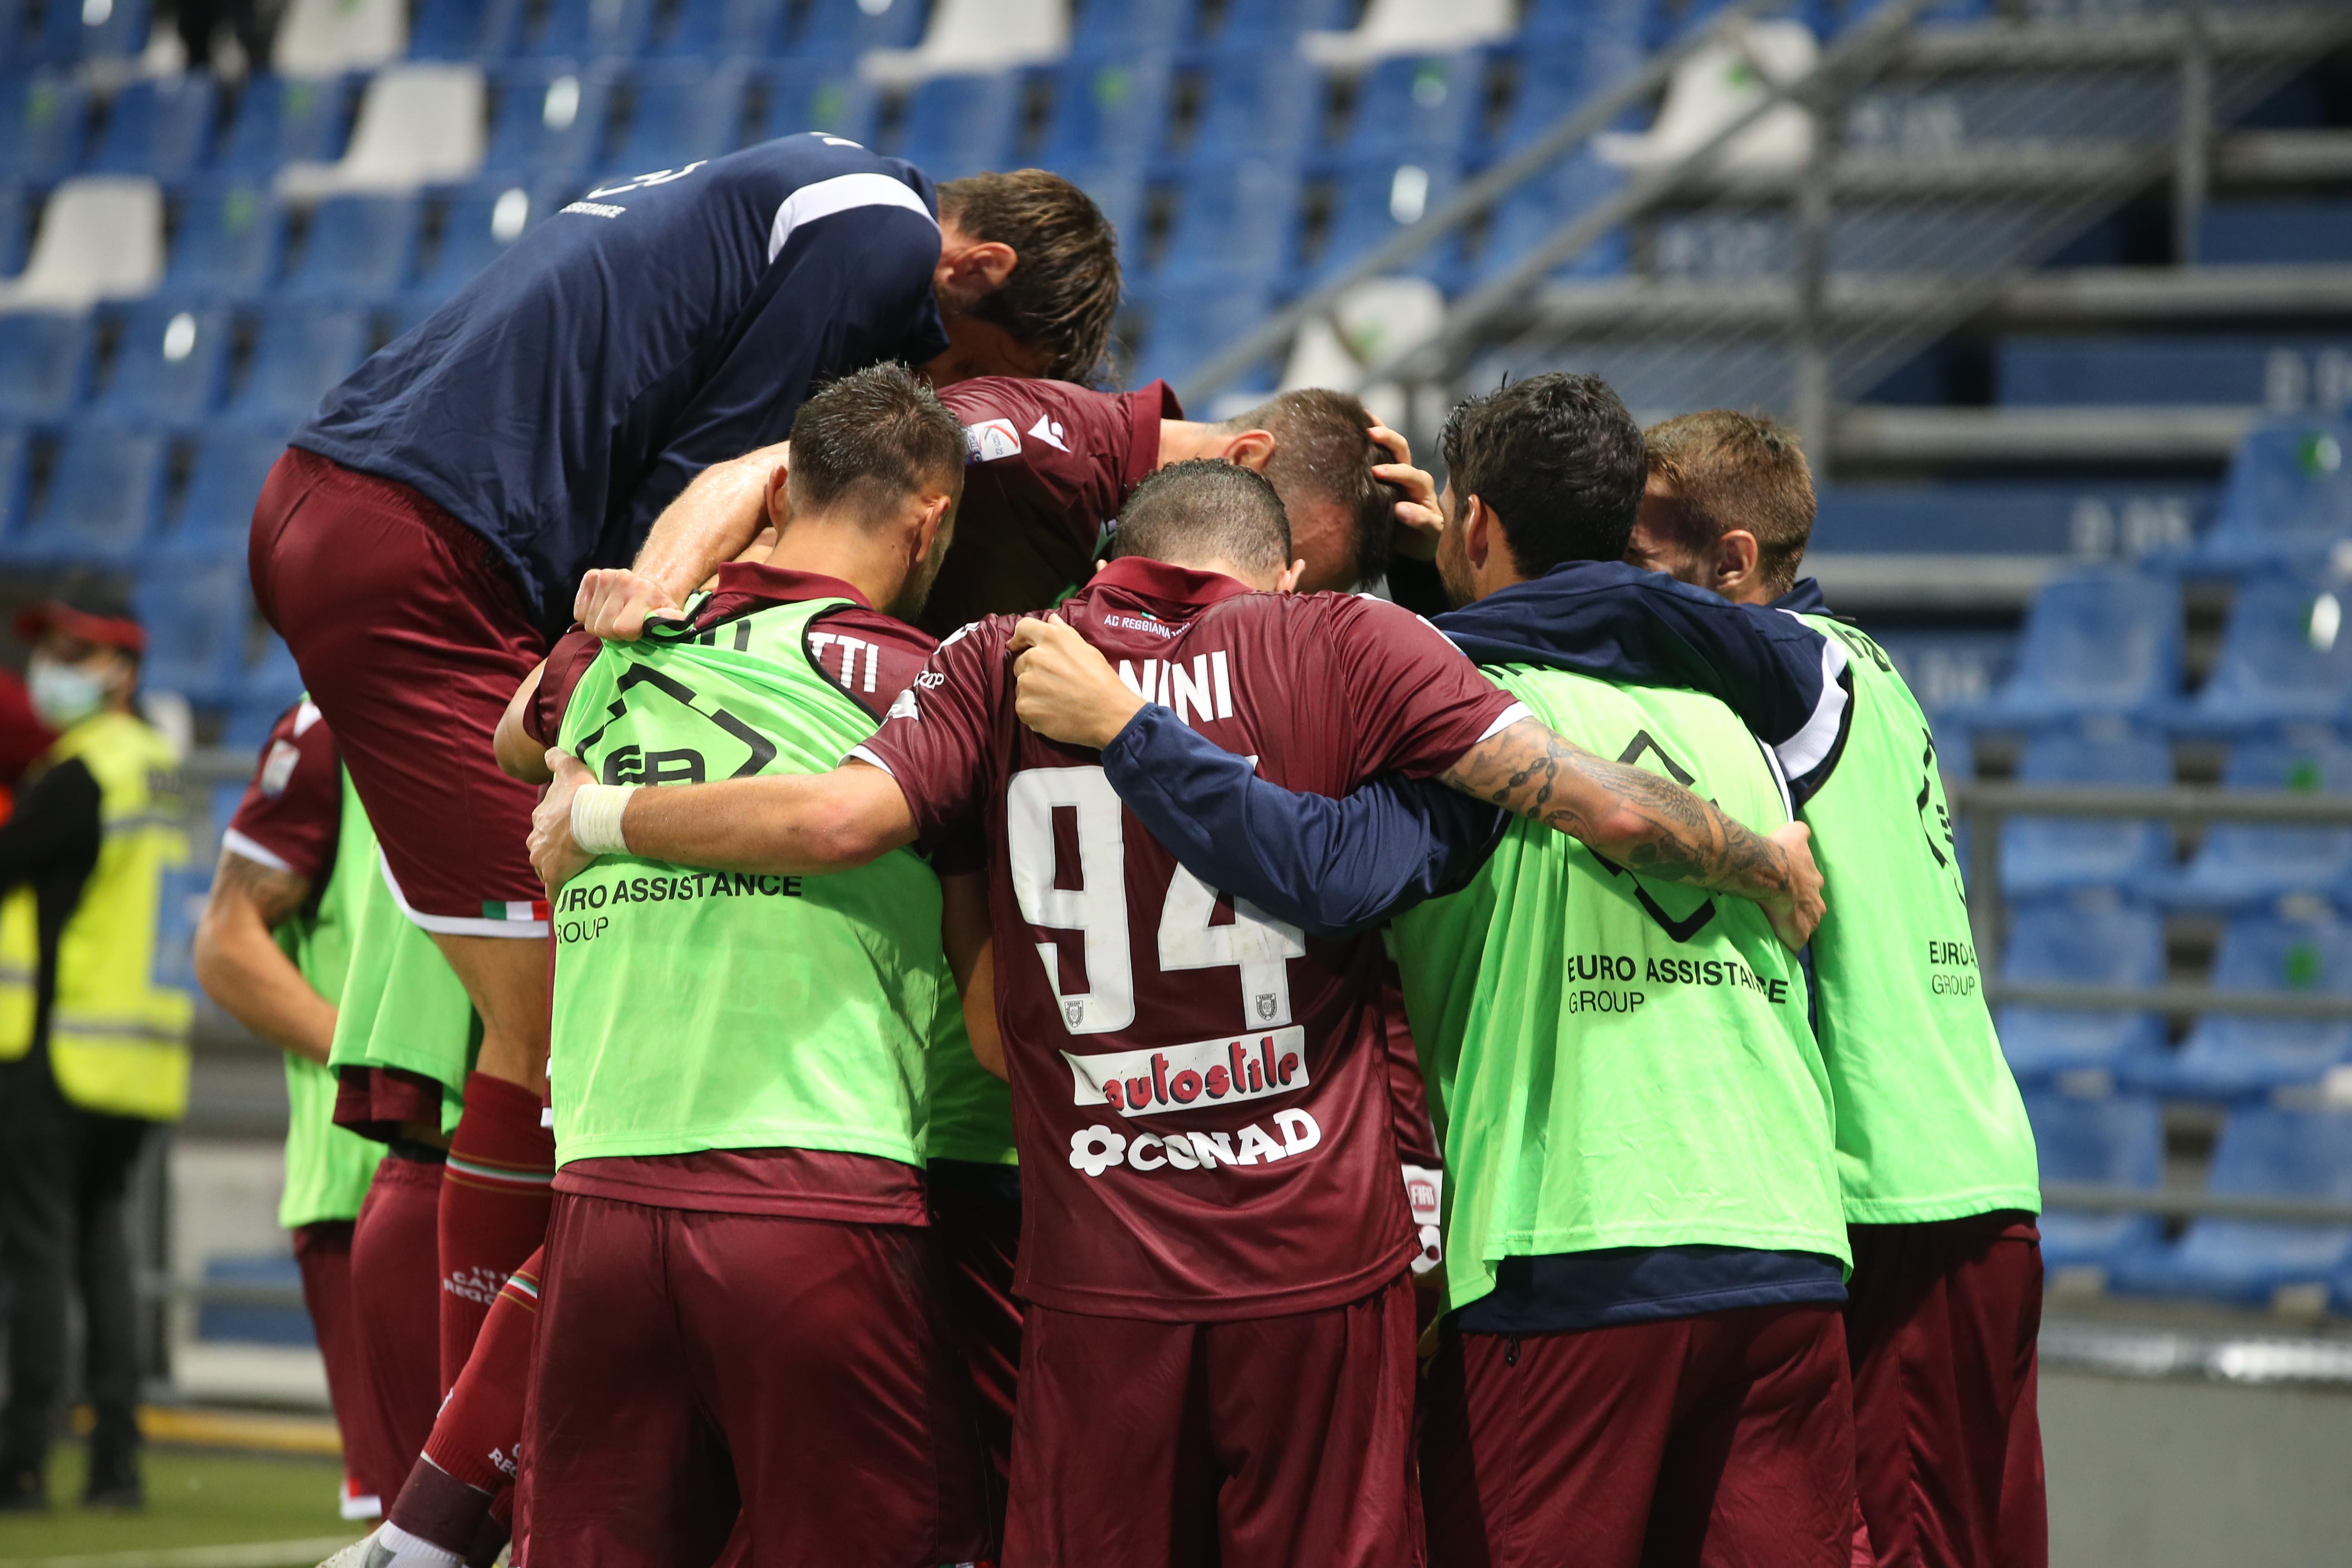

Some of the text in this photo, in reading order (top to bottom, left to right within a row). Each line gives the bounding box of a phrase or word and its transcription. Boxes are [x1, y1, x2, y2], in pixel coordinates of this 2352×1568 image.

[1104, 614, 1120, 627] AC
[1122, 617, 1171, 640] REGGIANA
[808, 632, 879, 693] TTI
[1118, 650, 1233, 726] NINI
[611, 872, 803, 904] ASSISTANCE
[1007, 755, 1306, 1034] 94
[557, 916, 609, 944] ROUP
[1929, 941, 1969, 965] EURO
[1568, 954, 1637, 983] EURO
[1931, 974, 1975, 996] GROUP
[1568, 990, 1645, 1014] GROUP
[1102, 1036, 1299, 1112] autostile
[1127, 1107, 1321, 1171] CONAD
[1411, 1185, 1435, 1206] FIAT
[442, 1277, 497, 1307] REGG
[452, 1271, 500, 1294] CAL
